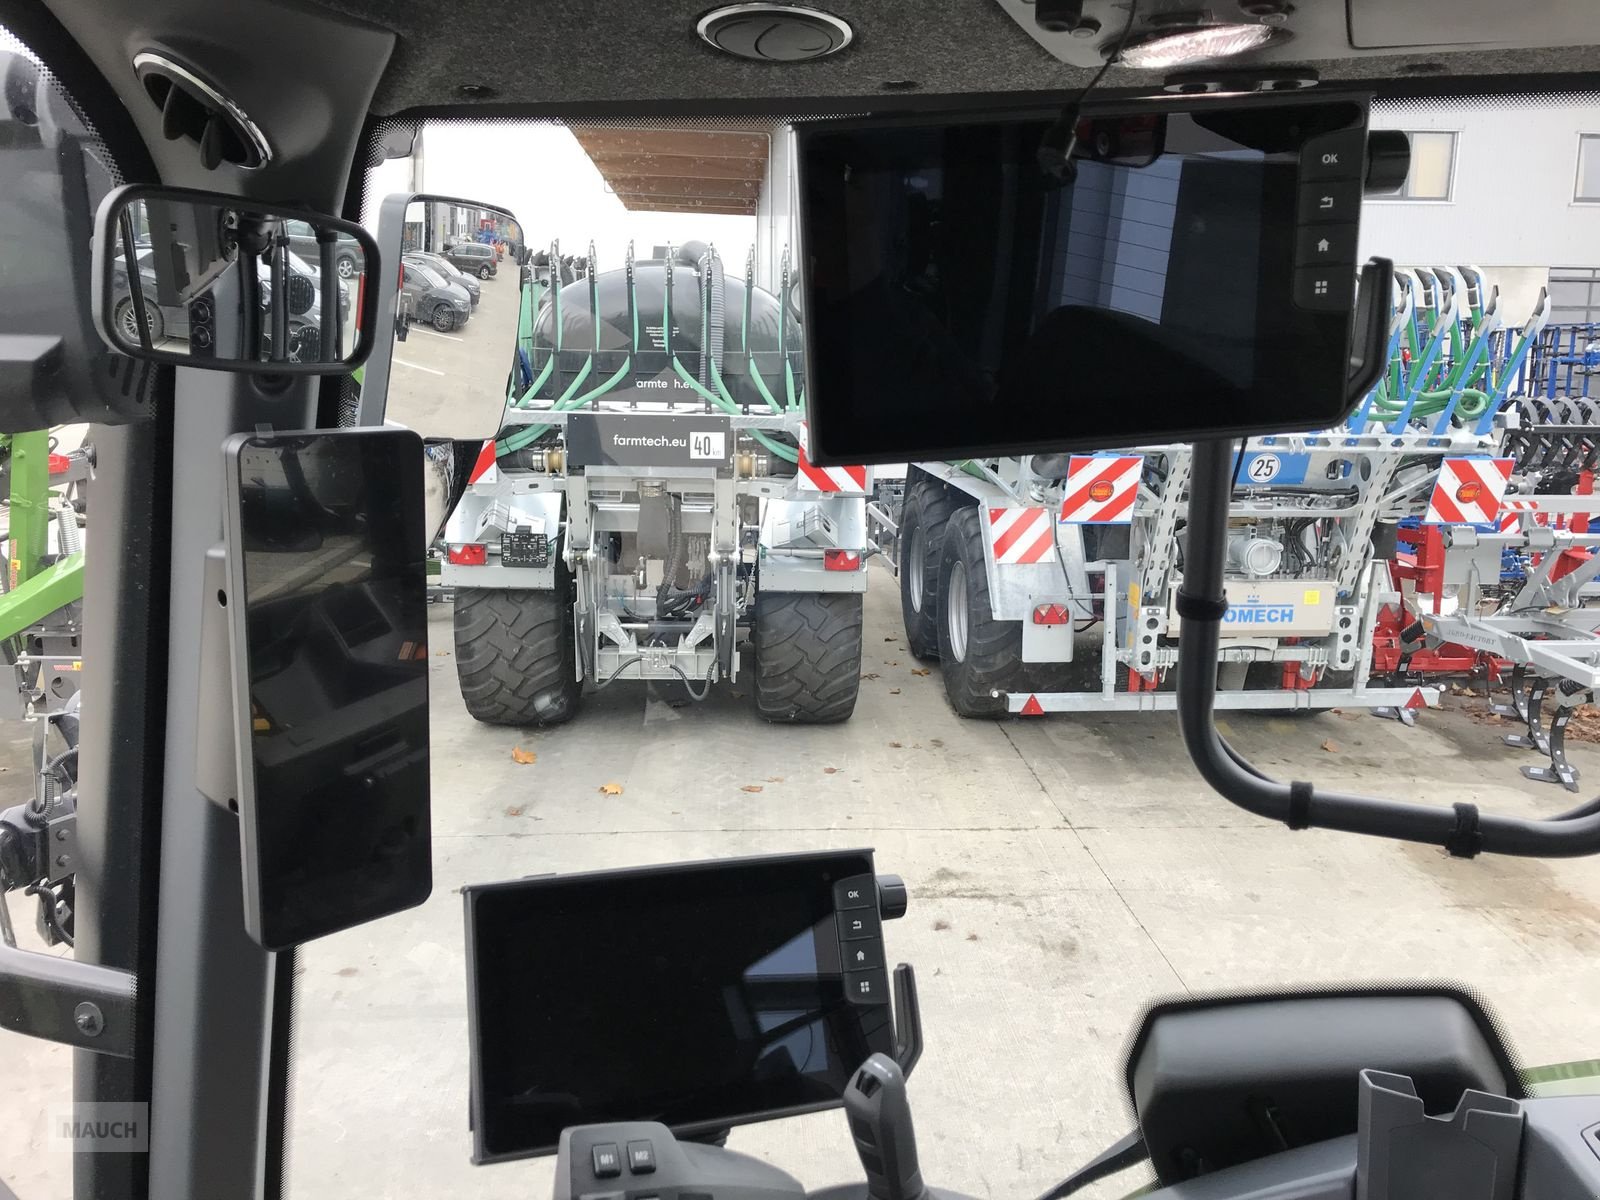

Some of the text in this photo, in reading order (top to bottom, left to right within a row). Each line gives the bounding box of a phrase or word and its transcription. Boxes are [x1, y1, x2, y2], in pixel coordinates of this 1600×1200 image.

[1322, 153, 1338, 163] OK
[613, 434, 687, 447] farmtech.eu
[694, 436, 711, 456] 40
[1253, 459, 1275, 476] 25
[1223, 609, 1294, 622] OMECH
[847, 890, 860, 898] OK
[600, 1154, 613, 1166] M1
[635, 1150, 649, 1161] M2
